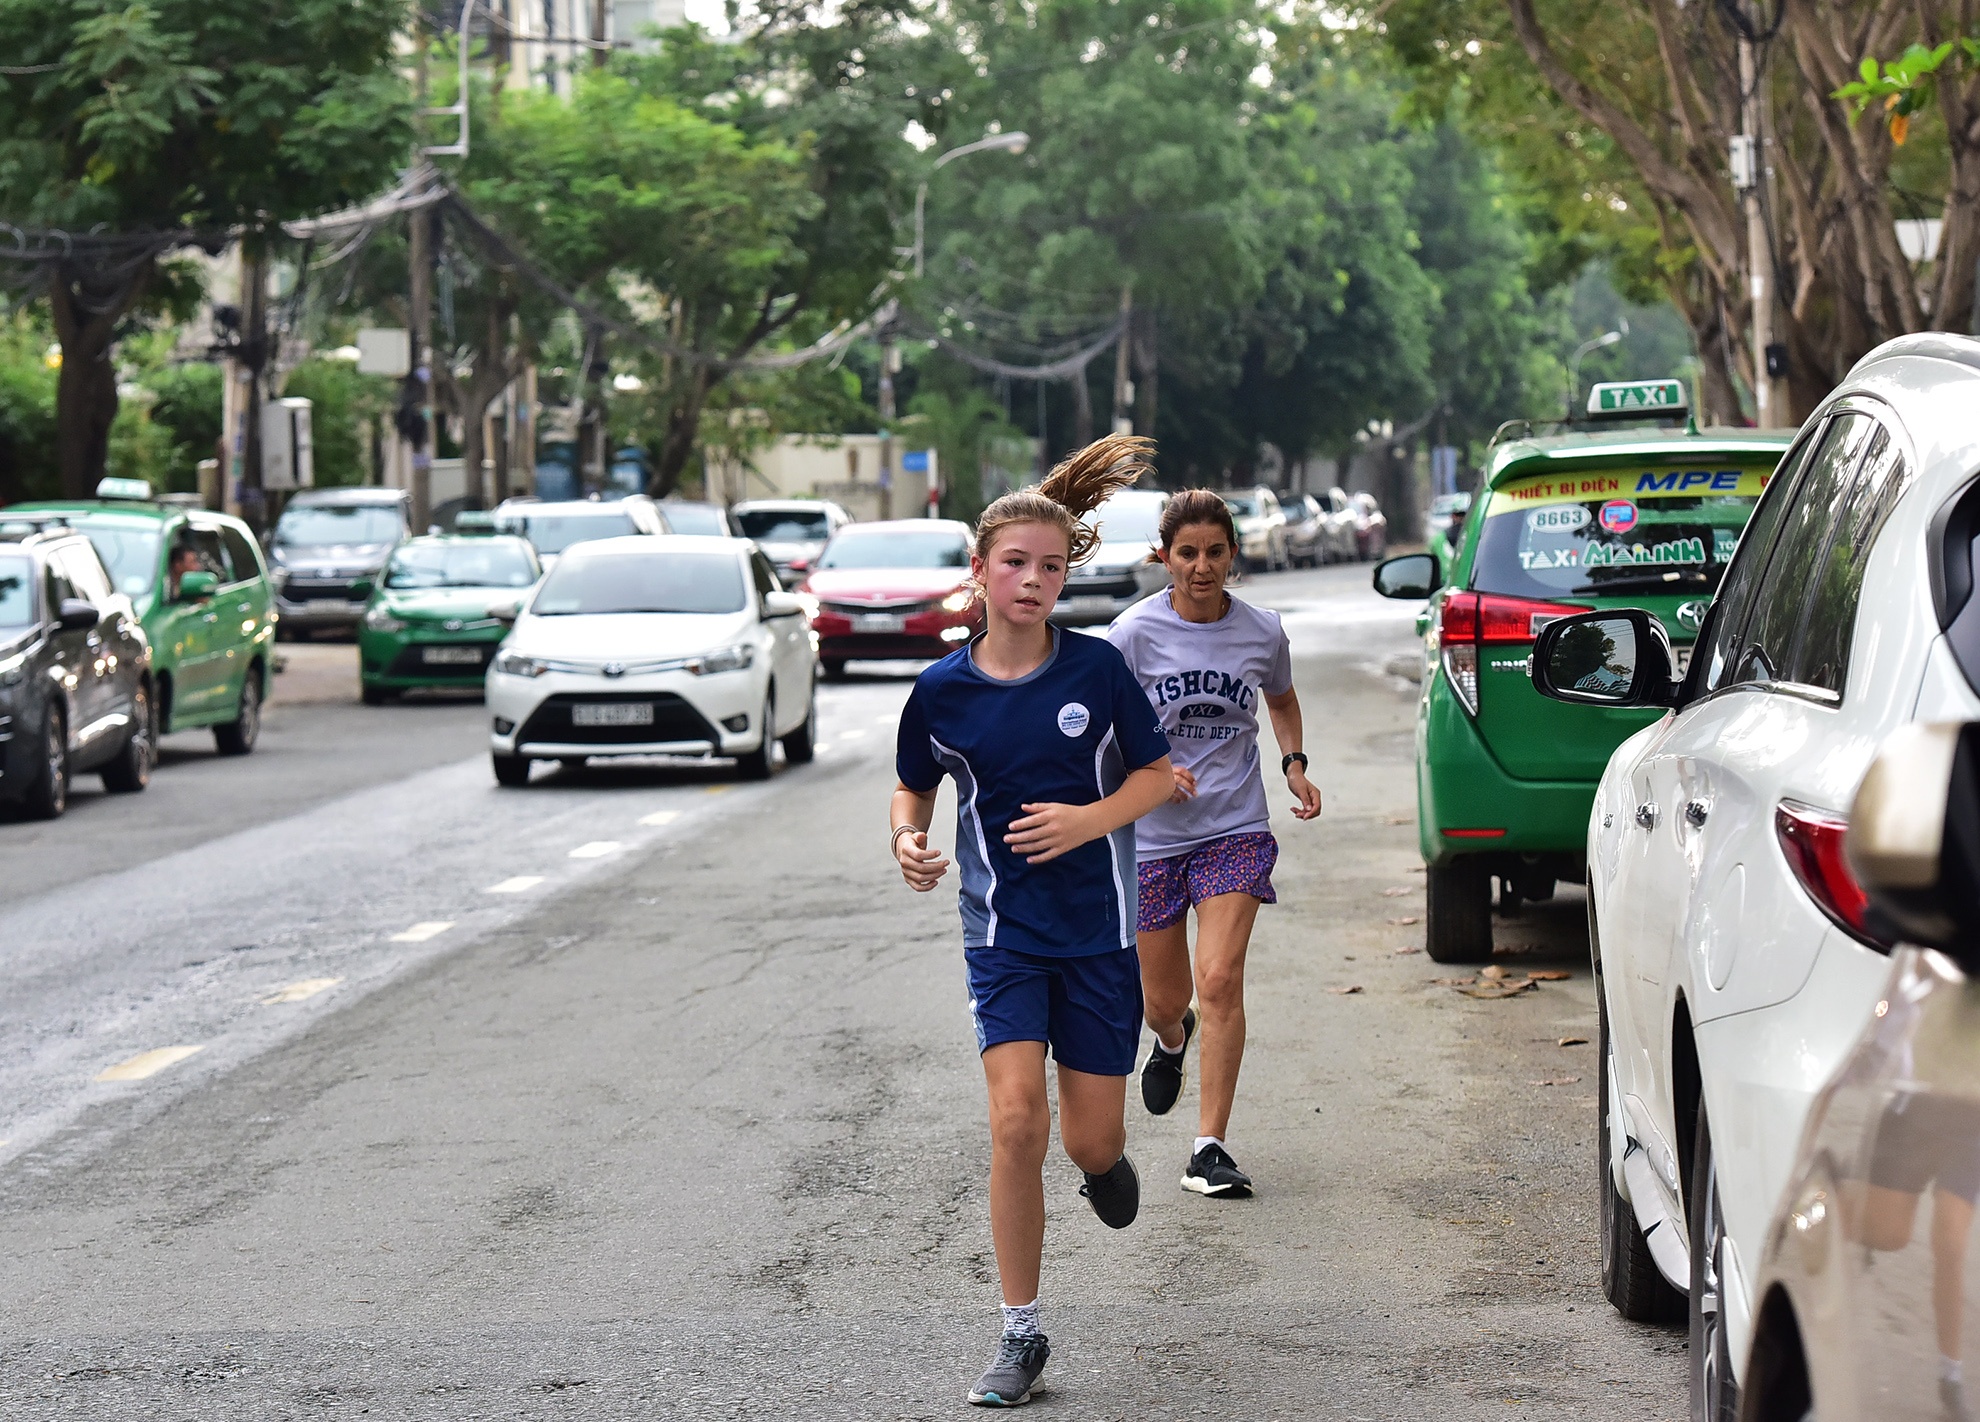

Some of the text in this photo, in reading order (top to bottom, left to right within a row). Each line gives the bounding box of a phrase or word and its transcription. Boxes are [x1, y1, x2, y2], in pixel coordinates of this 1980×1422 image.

[1635, 471, 1743, 492] MPE
[1536, 510, 1583, 526] 8663
[1718, 540, 1738, 552] TO
[1155, 670, 1253, 710] ISHCMC
[1187, 704, 1216, 718] XXL
[1210, 726, 1240, 740] DEPT
